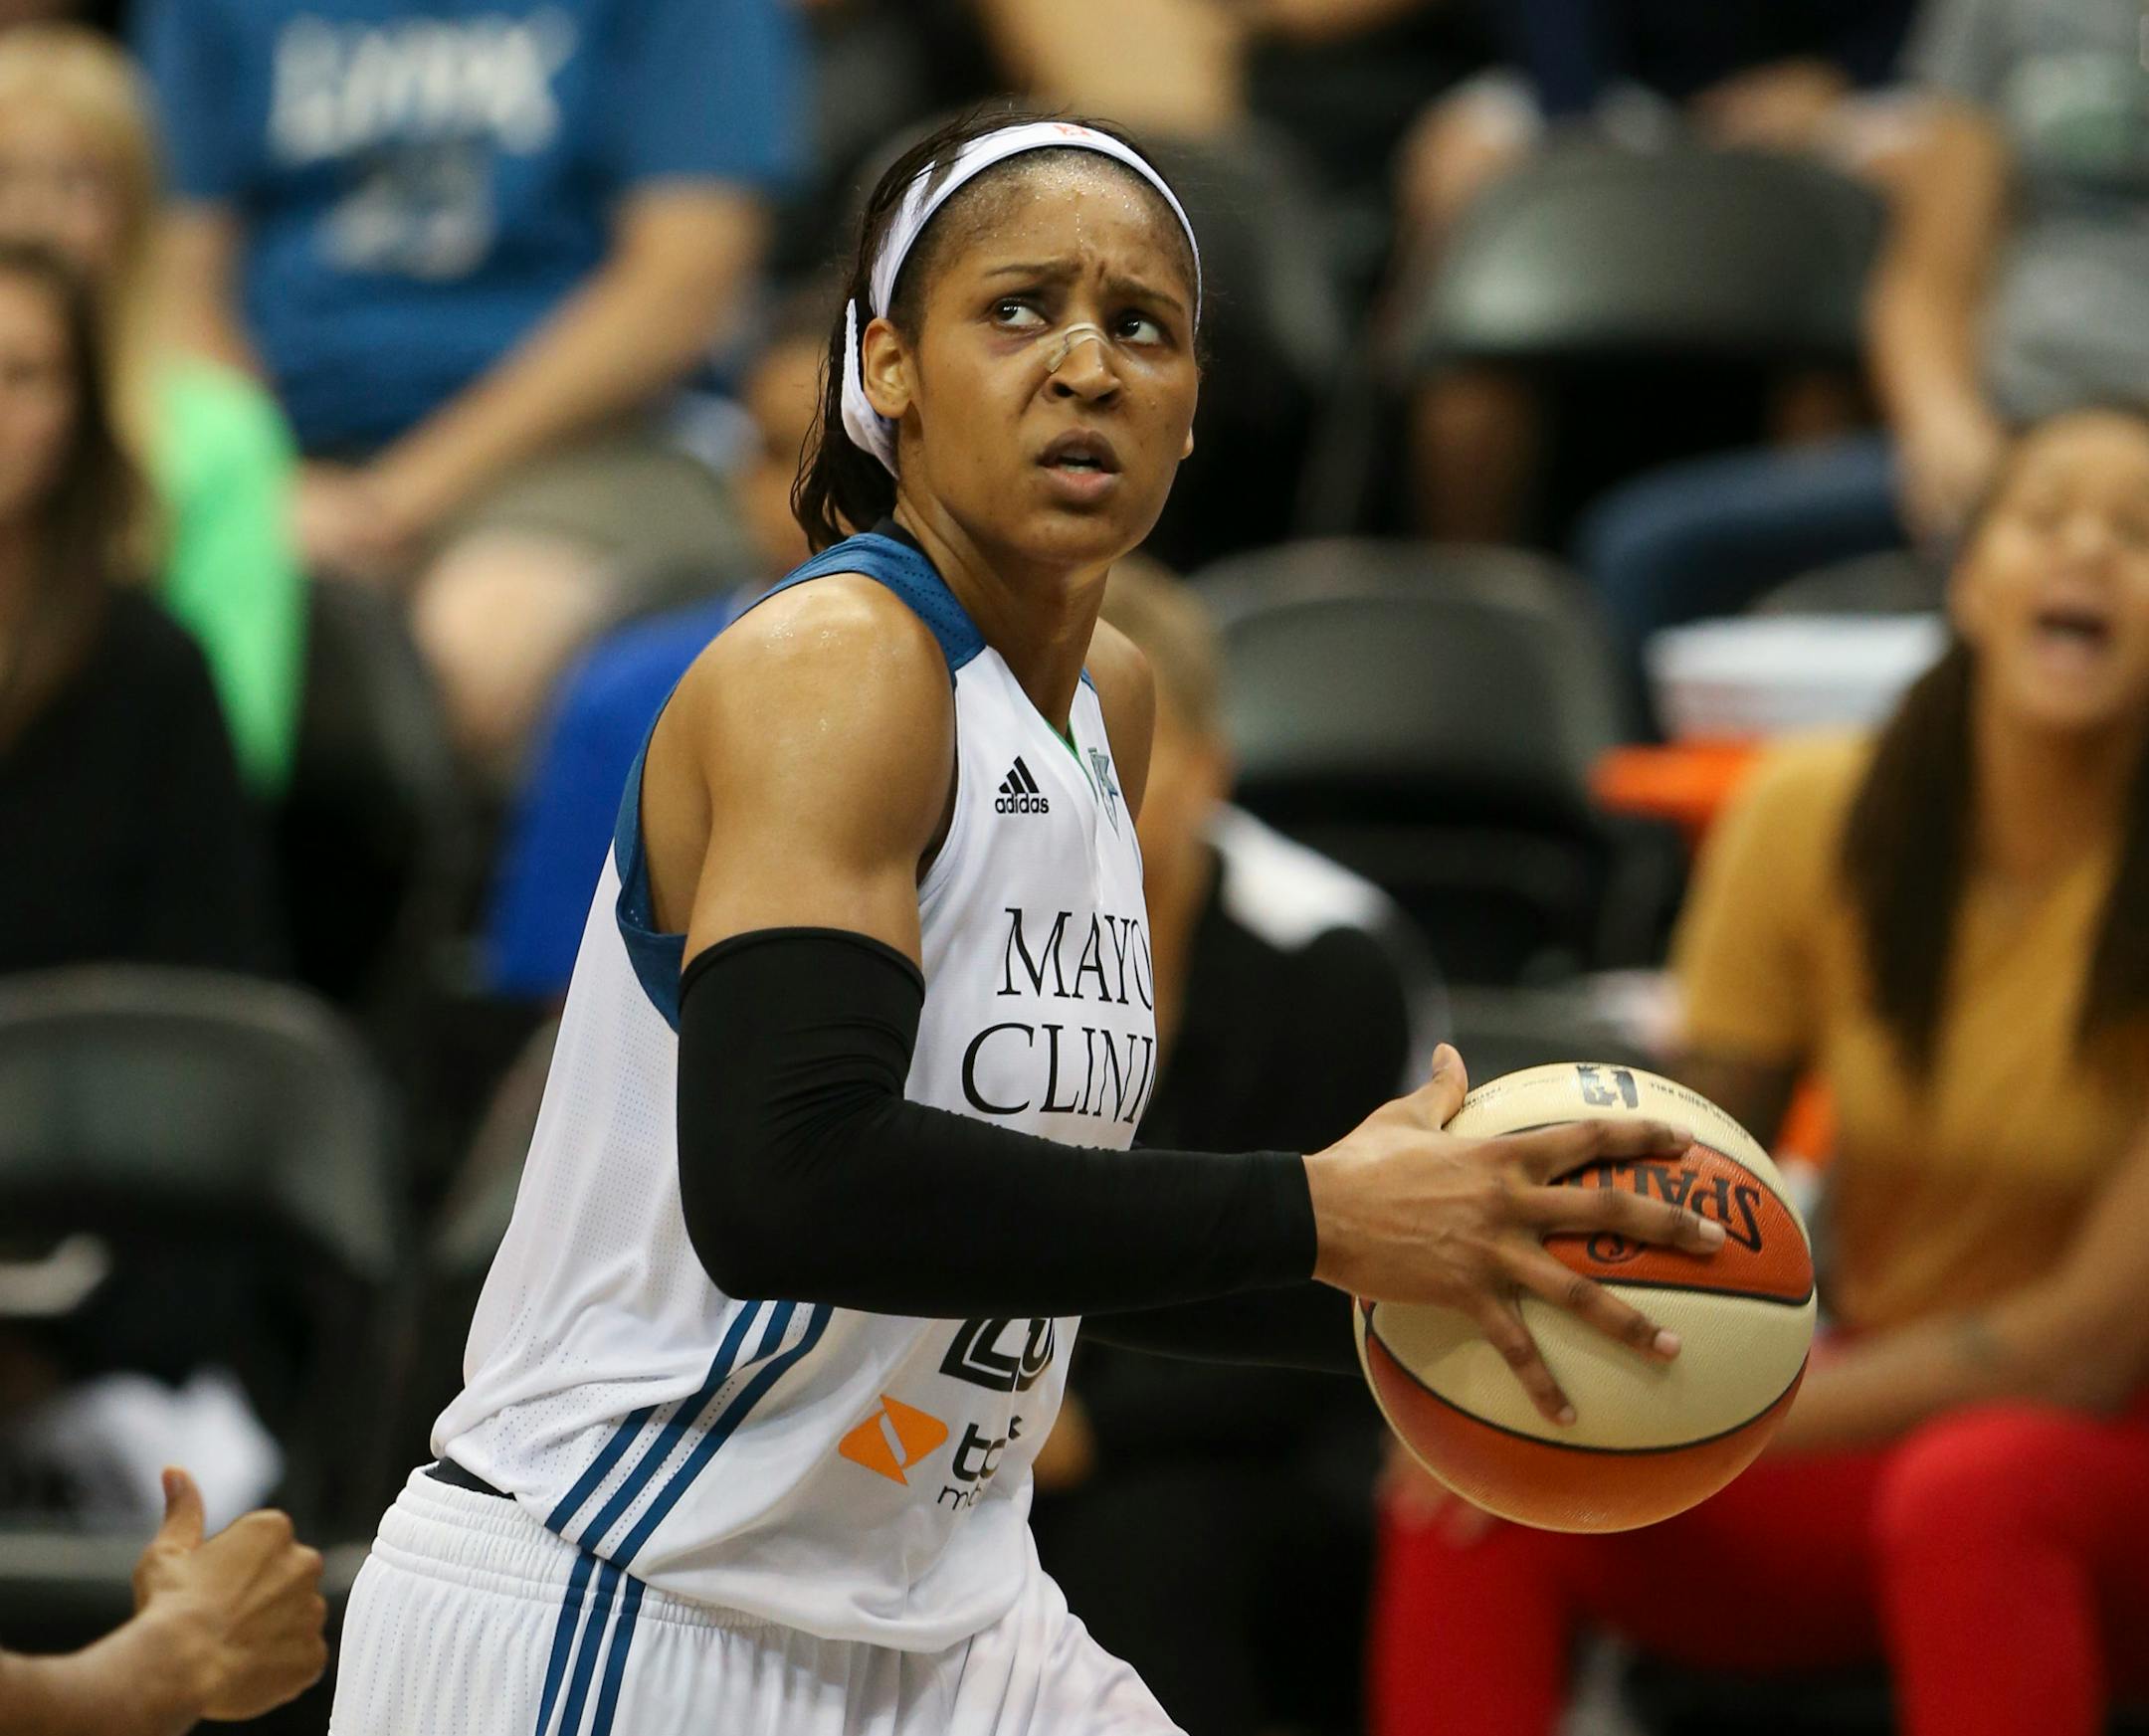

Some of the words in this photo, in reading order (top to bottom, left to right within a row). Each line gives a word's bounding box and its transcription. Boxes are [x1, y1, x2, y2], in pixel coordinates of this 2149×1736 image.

[995, 793, 1050, 814] adidas
[997, 907, 1153, 1011] MAYO
[961, 1023, 1156, 1124] CLINI
